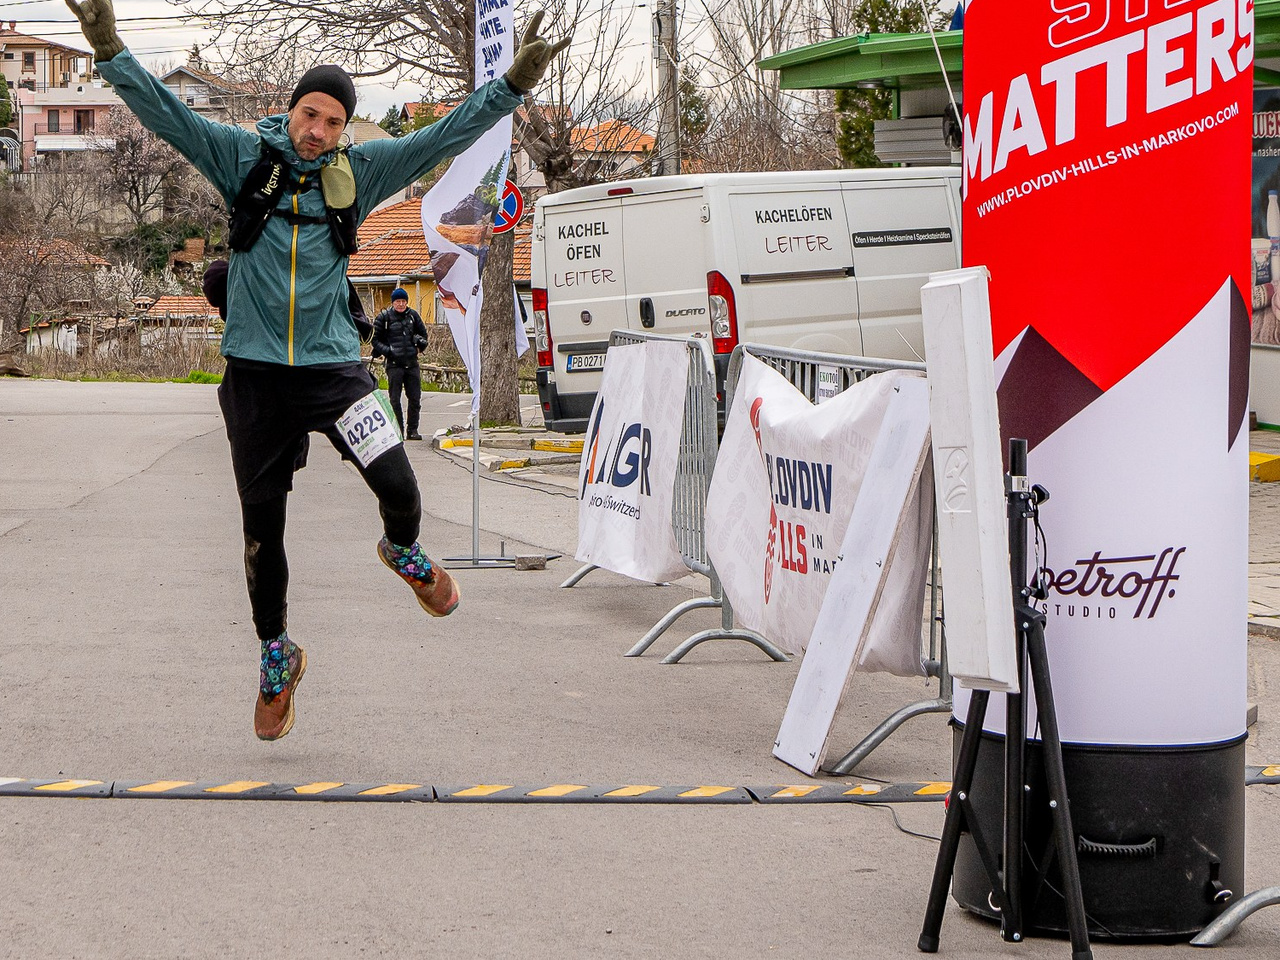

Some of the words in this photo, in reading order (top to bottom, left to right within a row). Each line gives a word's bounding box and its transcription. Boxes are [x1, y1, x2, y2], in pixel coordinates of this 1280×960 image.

[976, 101, 1240, 219] WWW.PLOVDIV-HILLS-IN-MARKOVO.COM
[754, 206, 833, 225] KACHELÖFEN
[557, 220, 610, 241] KACHEL
[566, 243, 601, 262] ÖFEN
[764, 234, 833, 255] LEITER
[553, 268, 617, 289] LEITER
[665, 307, 706, 318] DUCATO
[572, 356, 583, 368] PB
[346, 409, 387, 447] 4229
[811, 533, 823, 550] IN
[1041, 603, 1117, 620] STUDIO
